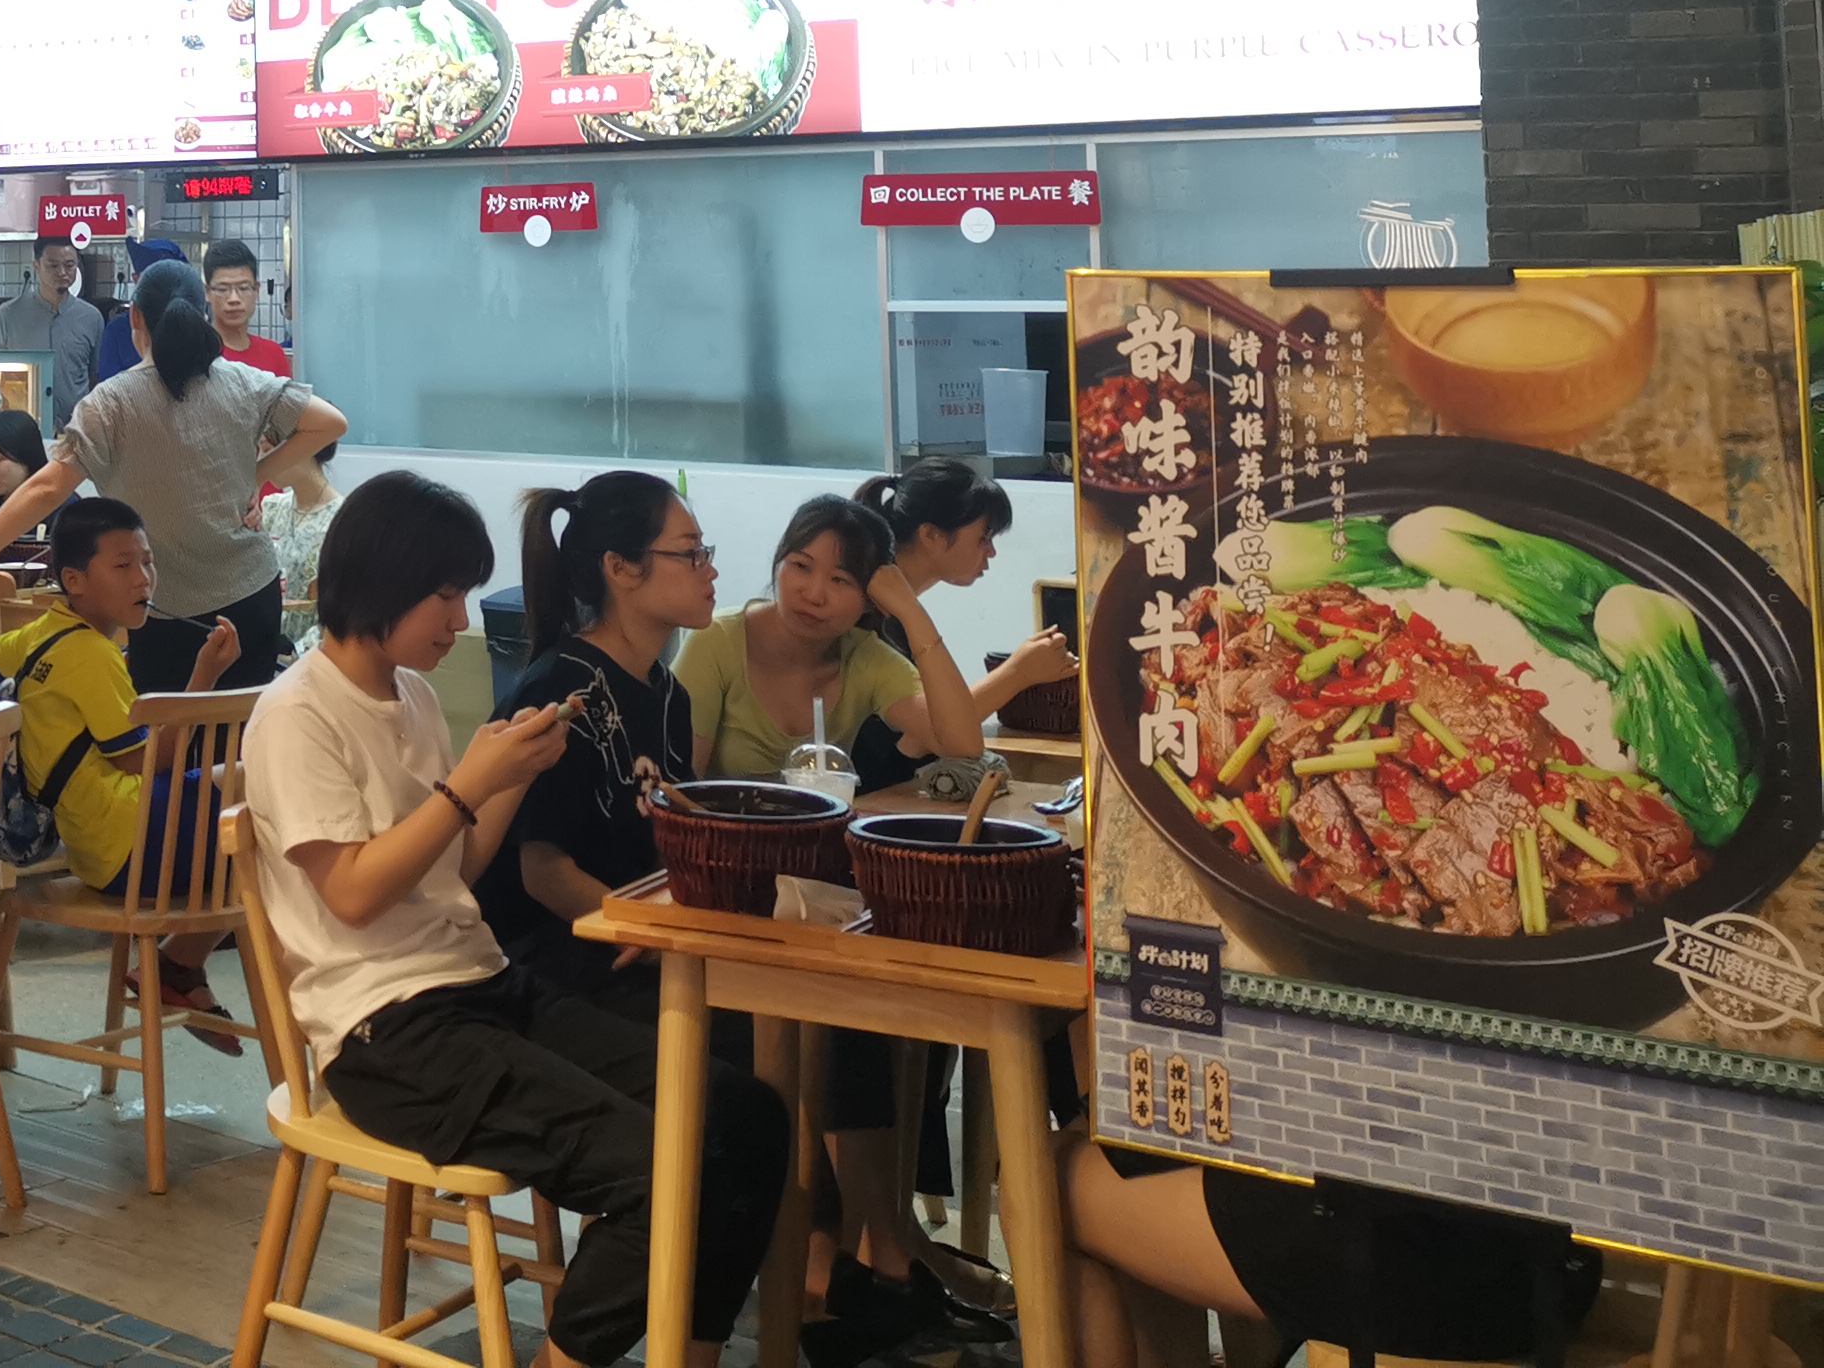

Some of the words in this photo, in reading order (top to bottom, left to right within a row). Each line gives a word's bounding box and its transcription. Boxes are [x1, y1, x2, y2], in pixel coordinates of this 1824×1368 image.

[486, 192, 508, 215] 炒
[509, 195, 567, 212] STIR-FRY
[569, 190, 591, 215] 炉
[870, 184, 890, 204] 回
[895, 187, 968, 203] COLLECT
[971, 186, 1005, 202] THE
[1008, 185, 1062, 201] PLATE
[1067, 178, 1094, 207] 餐
[44, 202, 58, 221] 出
[61, 205, 103, 219] OUTLET
[105, 200, 119, 222] 餐
[1116, 305, 1200, 777] 韵味酱牛肉
[1677, 936, 1808, 1008] 招牌推荐
